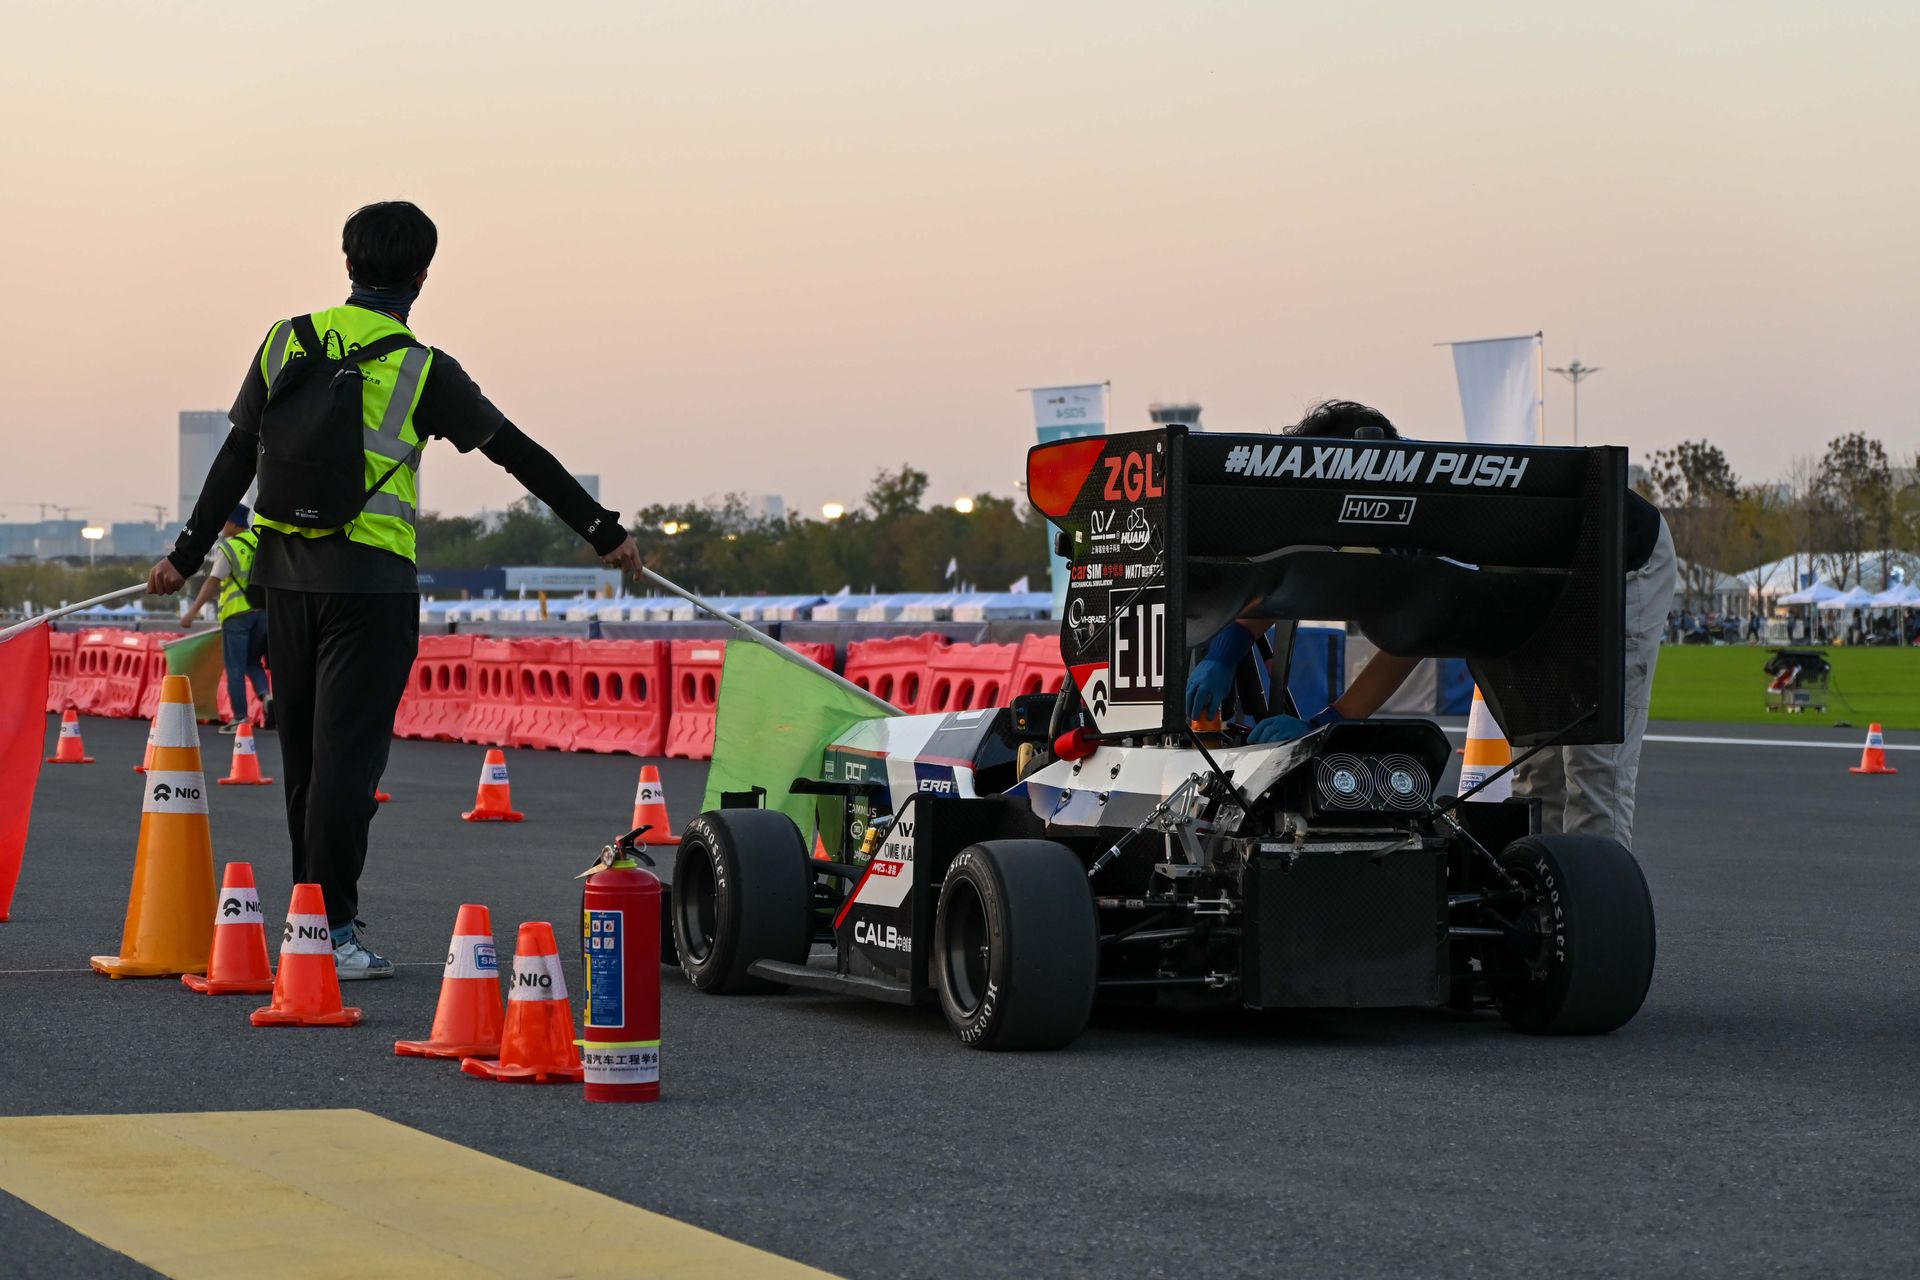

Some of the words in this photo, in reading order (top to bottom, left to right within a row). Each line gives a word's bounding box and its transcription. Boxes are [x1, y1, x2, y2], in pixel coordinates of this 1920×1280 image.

[1225, 445, 1425, 482] #MAXIMUM
[1425, 453, 1529, 488] PUSH
[1104, 452, 1166, 502] ZGL
[1345, 500, 1390, 519] HVD
[175, 787, 200, 800] NIO
[919, 779, 951, 793] ERA
[1535, 856, 1565, 963] Hoosier
[298, 926, 328, 940] NIO
[854, 921, 897, 949] CALB
[519, 973, 552, 988] NIO
[584, 1052, 658, 1066] 国汽车工程学会
